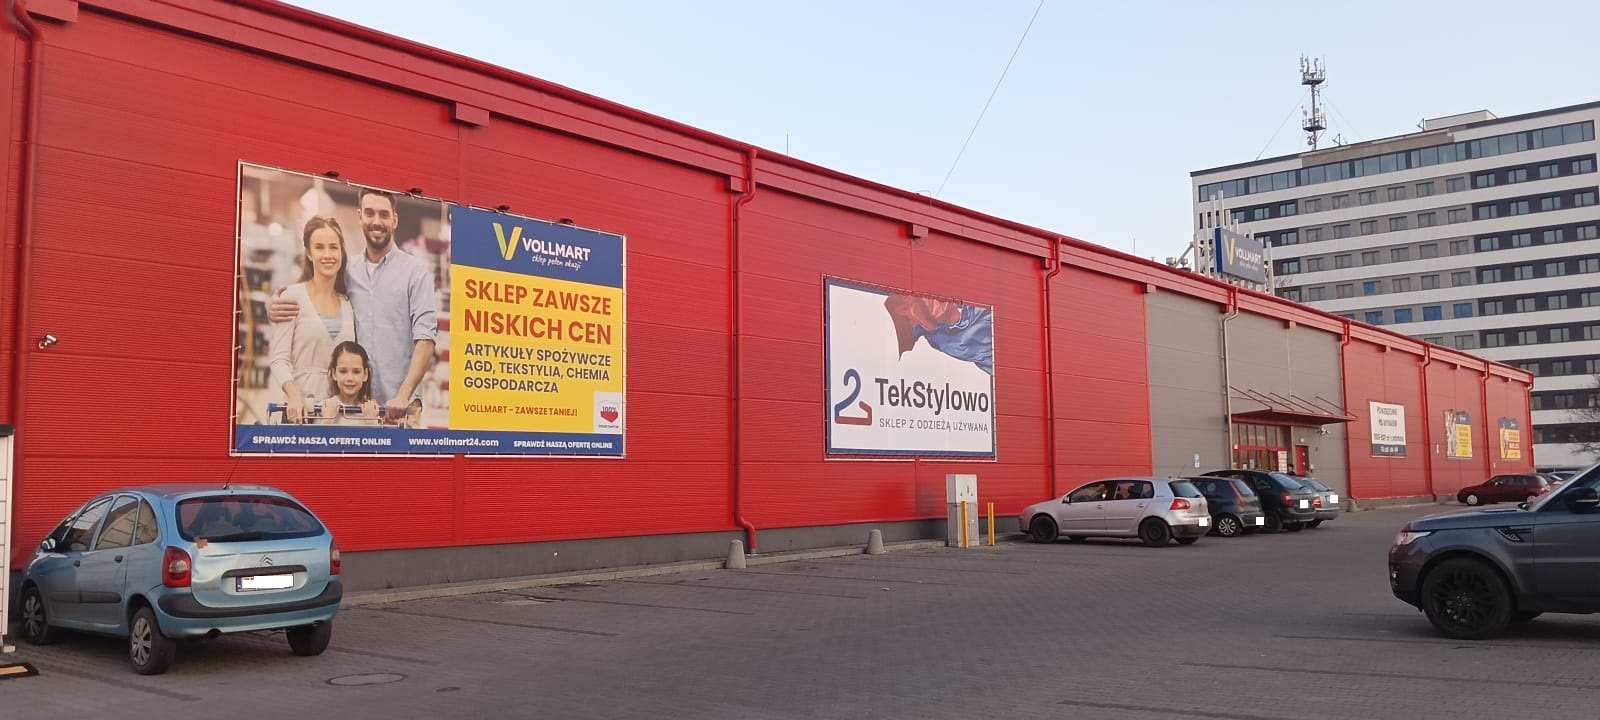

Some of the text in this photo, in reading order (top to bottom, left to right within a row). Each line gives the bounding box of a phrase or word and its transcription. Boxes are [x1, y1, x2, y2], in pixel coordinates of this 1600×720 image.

[522, 237, 591, 261] VOLLMART
[531, 254, 547, 266] sklep
[465, 279, 612, 316] SKLEP ZAWSZE
[464, 309, 611, 345] NISKICH CEN
[464, 343, 611, 367] ARTYKUŁY SPOŻYWCZE
[464, 360, 610, 381] AGD, TEKSTYLIA, CHEMIA
[464, 376, 559, 393] GOSPODARCZA
[875, 377, 989, 416] TekStylowo
[464, 404, 508, 415] VOLLMART
[515, 406, 549, 416] ZAWSZE
[548, 407, 578, 417] TANIEJ!
[879, 418, 989, 433] SKLEP Z ODZIEŻĄ UŻYWANĄ
[252, 435, 392, 446] SPRAWDŹ NASZĄ OFERTĘ ONLINE
[408, 437, 500, 447] www.vollmart24.com
[513, 440, 545, 449] SPRAWDŹ
[545, 441, 568, 450] NASZĄ
[567, 441, 591, 450] OFERTĘ
